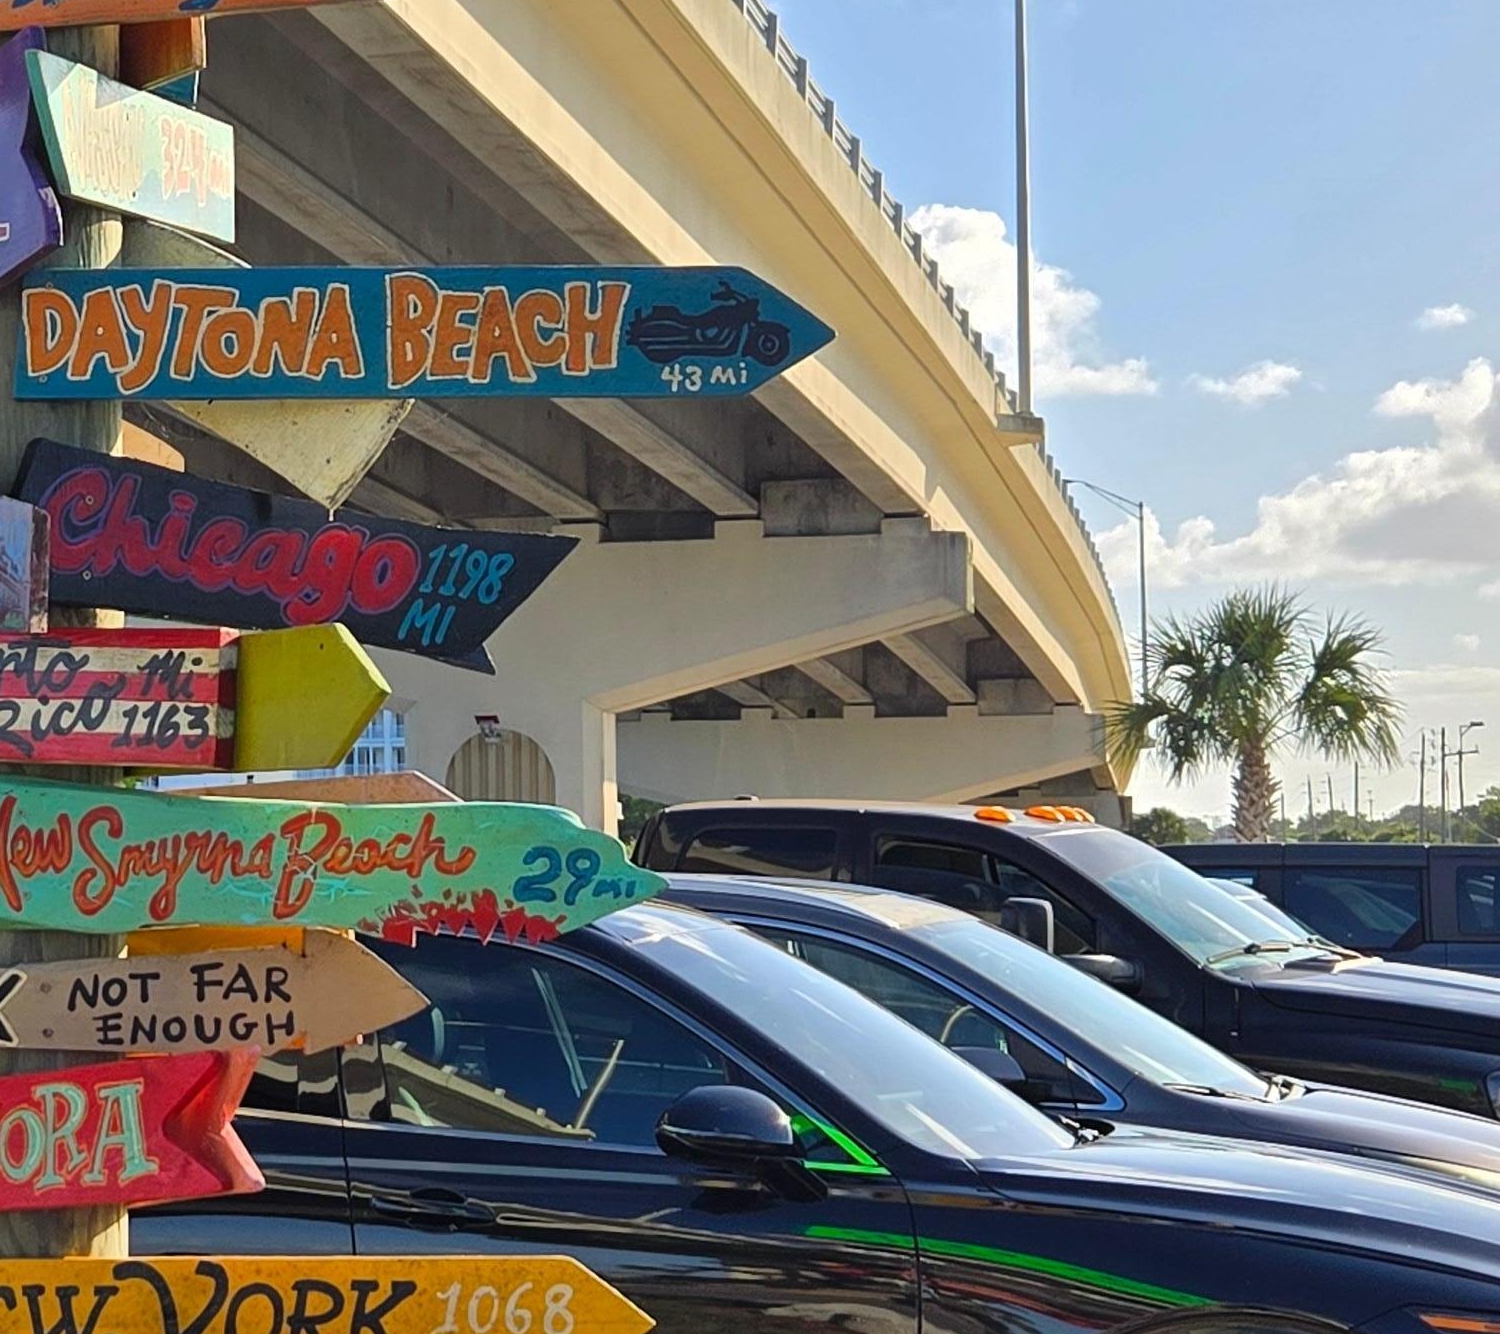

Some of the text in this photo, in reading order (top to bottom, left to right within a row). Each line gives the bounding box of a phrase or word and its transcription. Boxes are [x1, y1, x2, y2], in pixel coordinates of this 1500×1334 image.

[22, 272, 630, 395] DAYTONA BEACH
[660, 361, 748, 393] 43 Mi
[39, 467, 515, 626] Chicago 1198
[397, 597, 456, 647] MI
[137, 648, 204, 699] Mi
[119, 704, 211, 750] 1163
[71, 804, 274, 922] Smyrna
[271, 809, 477, 919] Beach
[513, 845, 601, 907] 29
[68, 961, 293, 1011] NOT FAR
[95, 1010, 296, 1046] ENOUGH
